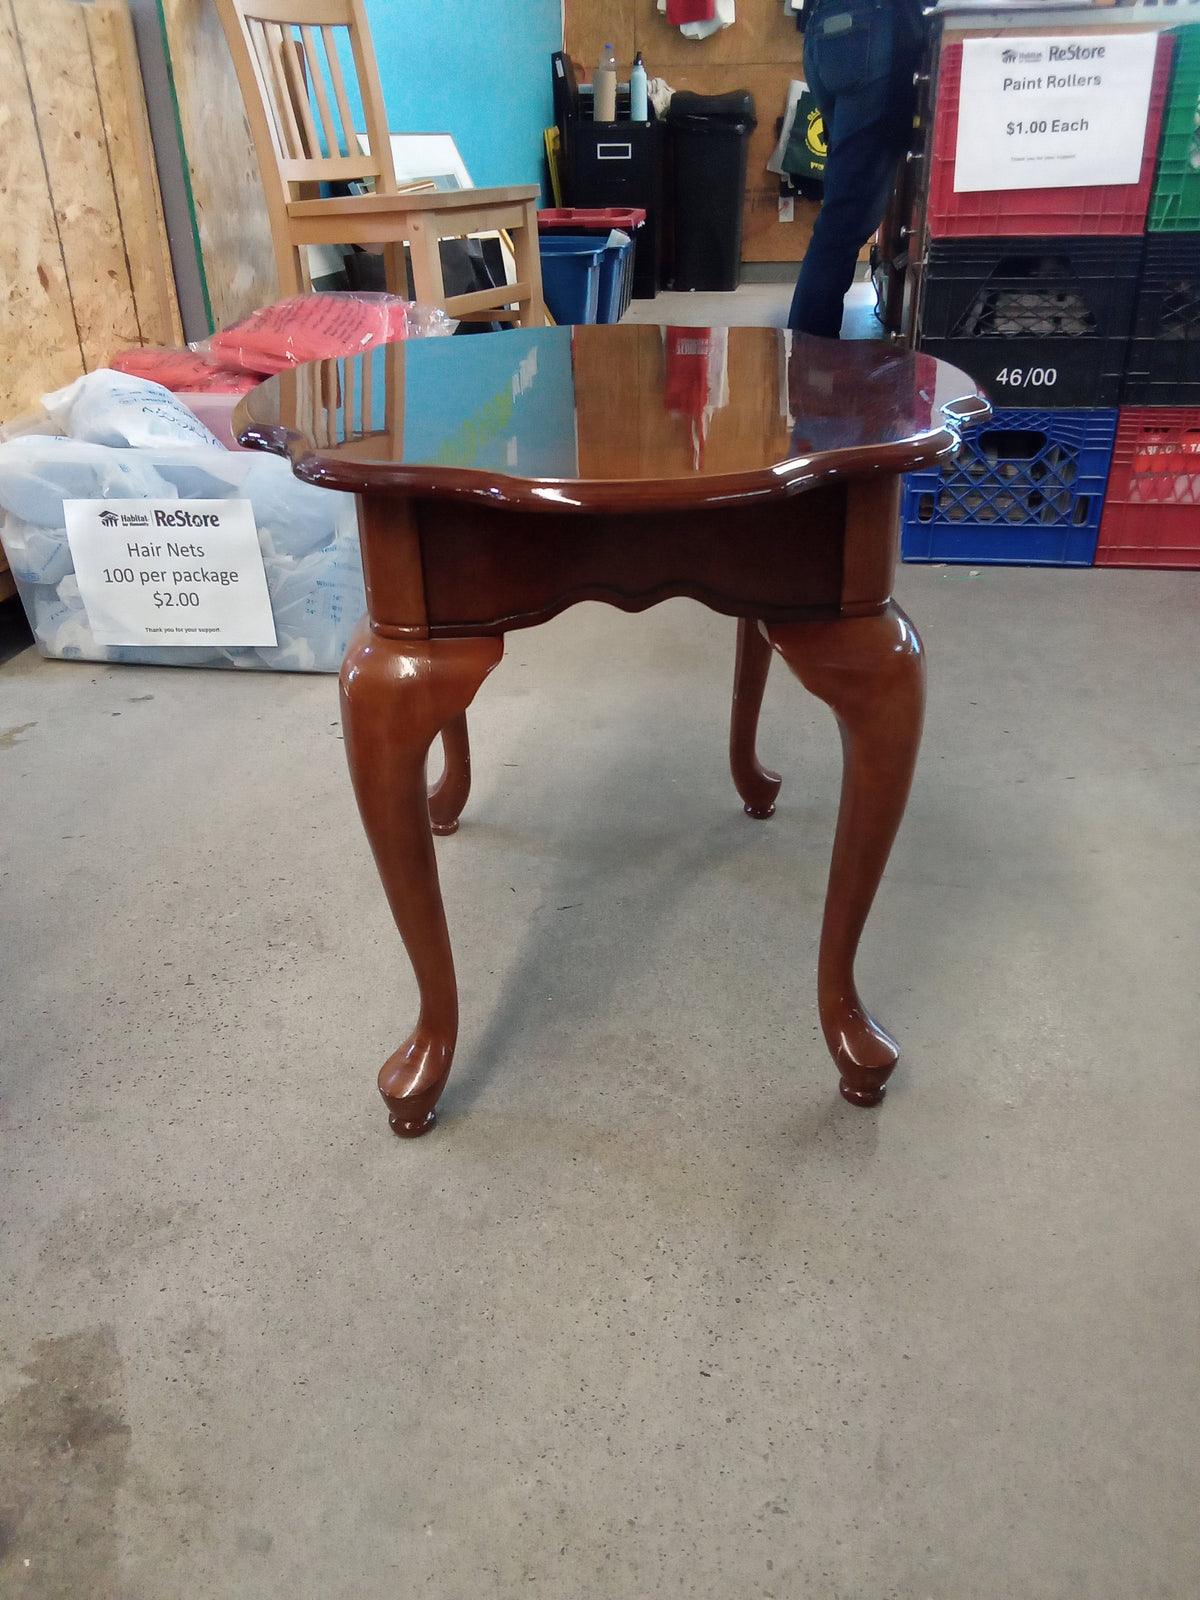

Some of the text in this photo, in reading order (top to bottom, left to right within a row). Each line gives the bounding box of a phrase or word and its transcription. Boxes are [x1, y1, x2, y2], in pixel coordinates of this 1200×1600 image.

[1049, 44, 1106, 61] ReStore
[1003, 74, 1102, 91] Paint Rollers
[1006, 118, 1089, 136] $1.00 Each
[996, 367, 1057, 388] 46/00
[153, 509, 220, 527] ReStore
[126, 542, 205, 557] Hair Nets
[103, 567, 239, 586] 100 per package
[153, 591, 200, 608] $2.00
